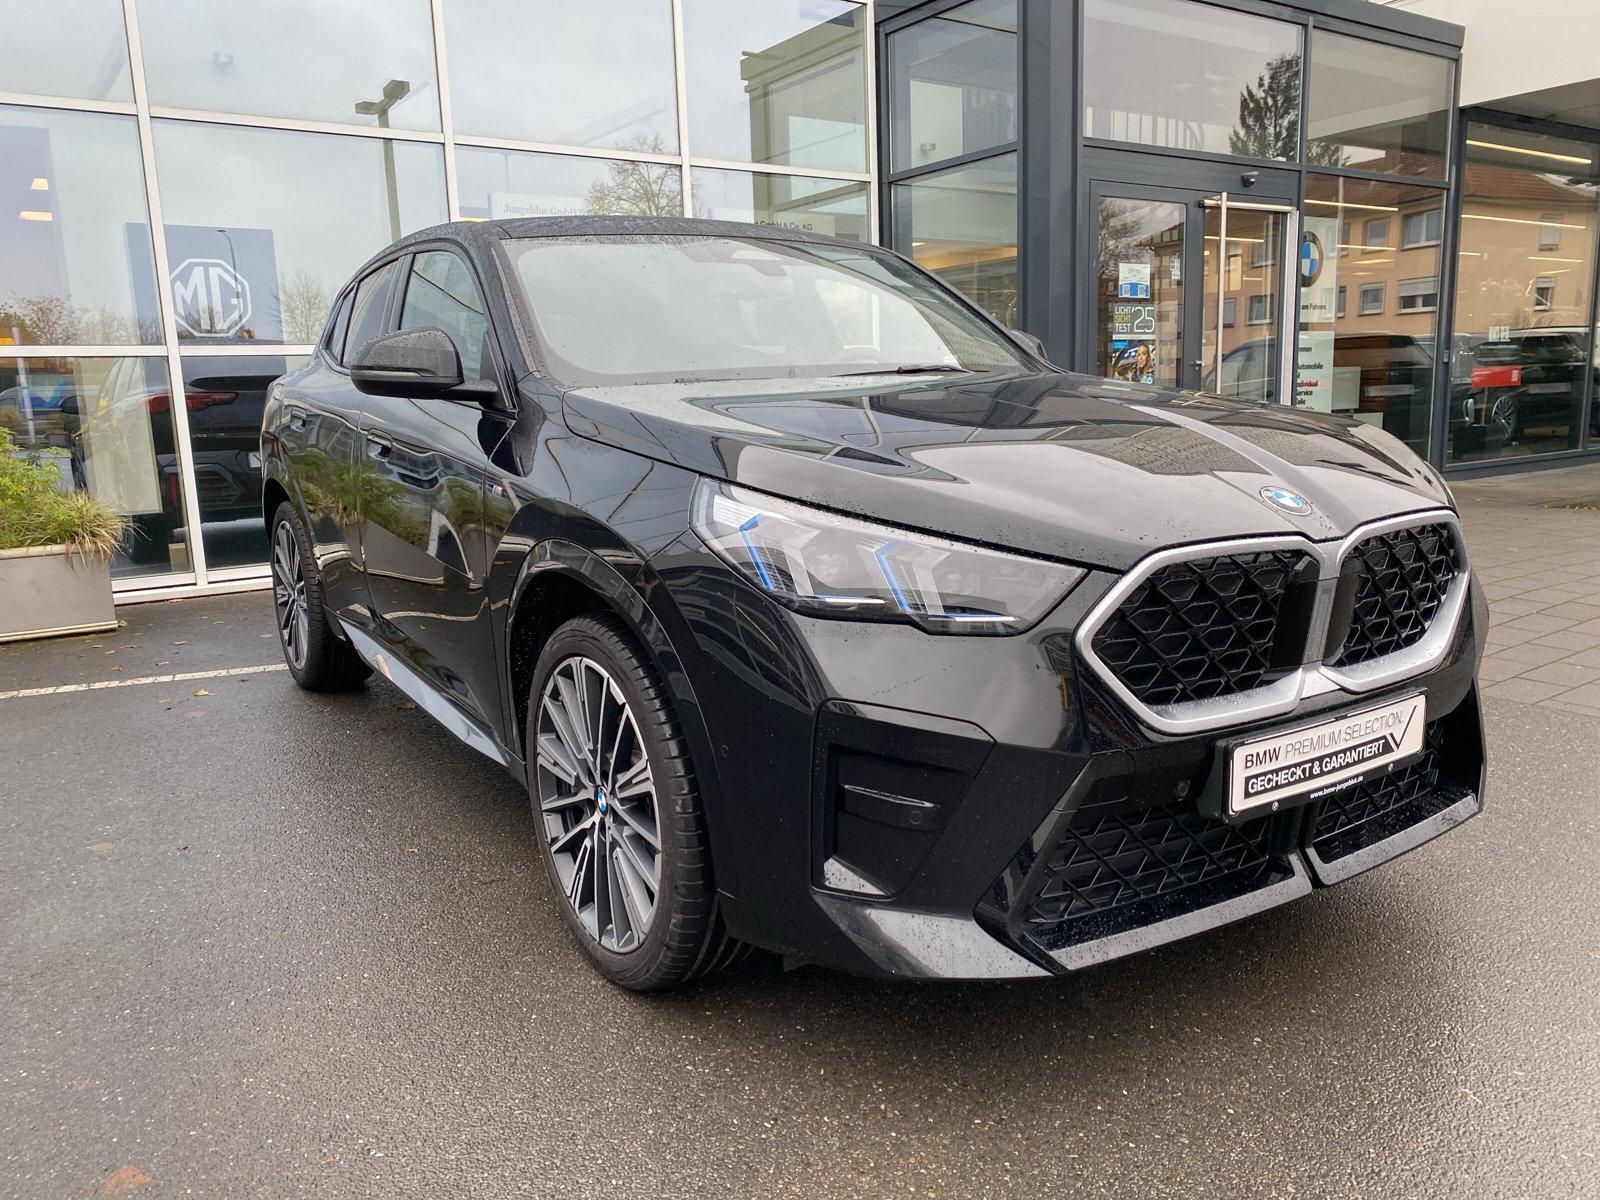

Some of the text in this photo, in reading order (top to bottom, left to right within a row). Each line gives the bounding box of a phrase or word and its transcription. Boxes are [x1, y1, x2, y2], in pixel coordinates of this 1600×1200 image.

[503, 203, 547, 216] Jungeblut
[802, 223, 813, 231] KG
[174, 266, 244, 330] MG
[1115, 306, 1131, 314] LICHT
[1115, 315, 1131, 323] SICHT
[1115, 324, 1131, 332] TEST
[1244, 746, 1282, 770] BMW
[1285, 728, 1342, 758] PREMIUM
[1248, 739, 1386, 794] GECHECKT & GARANTIERT
